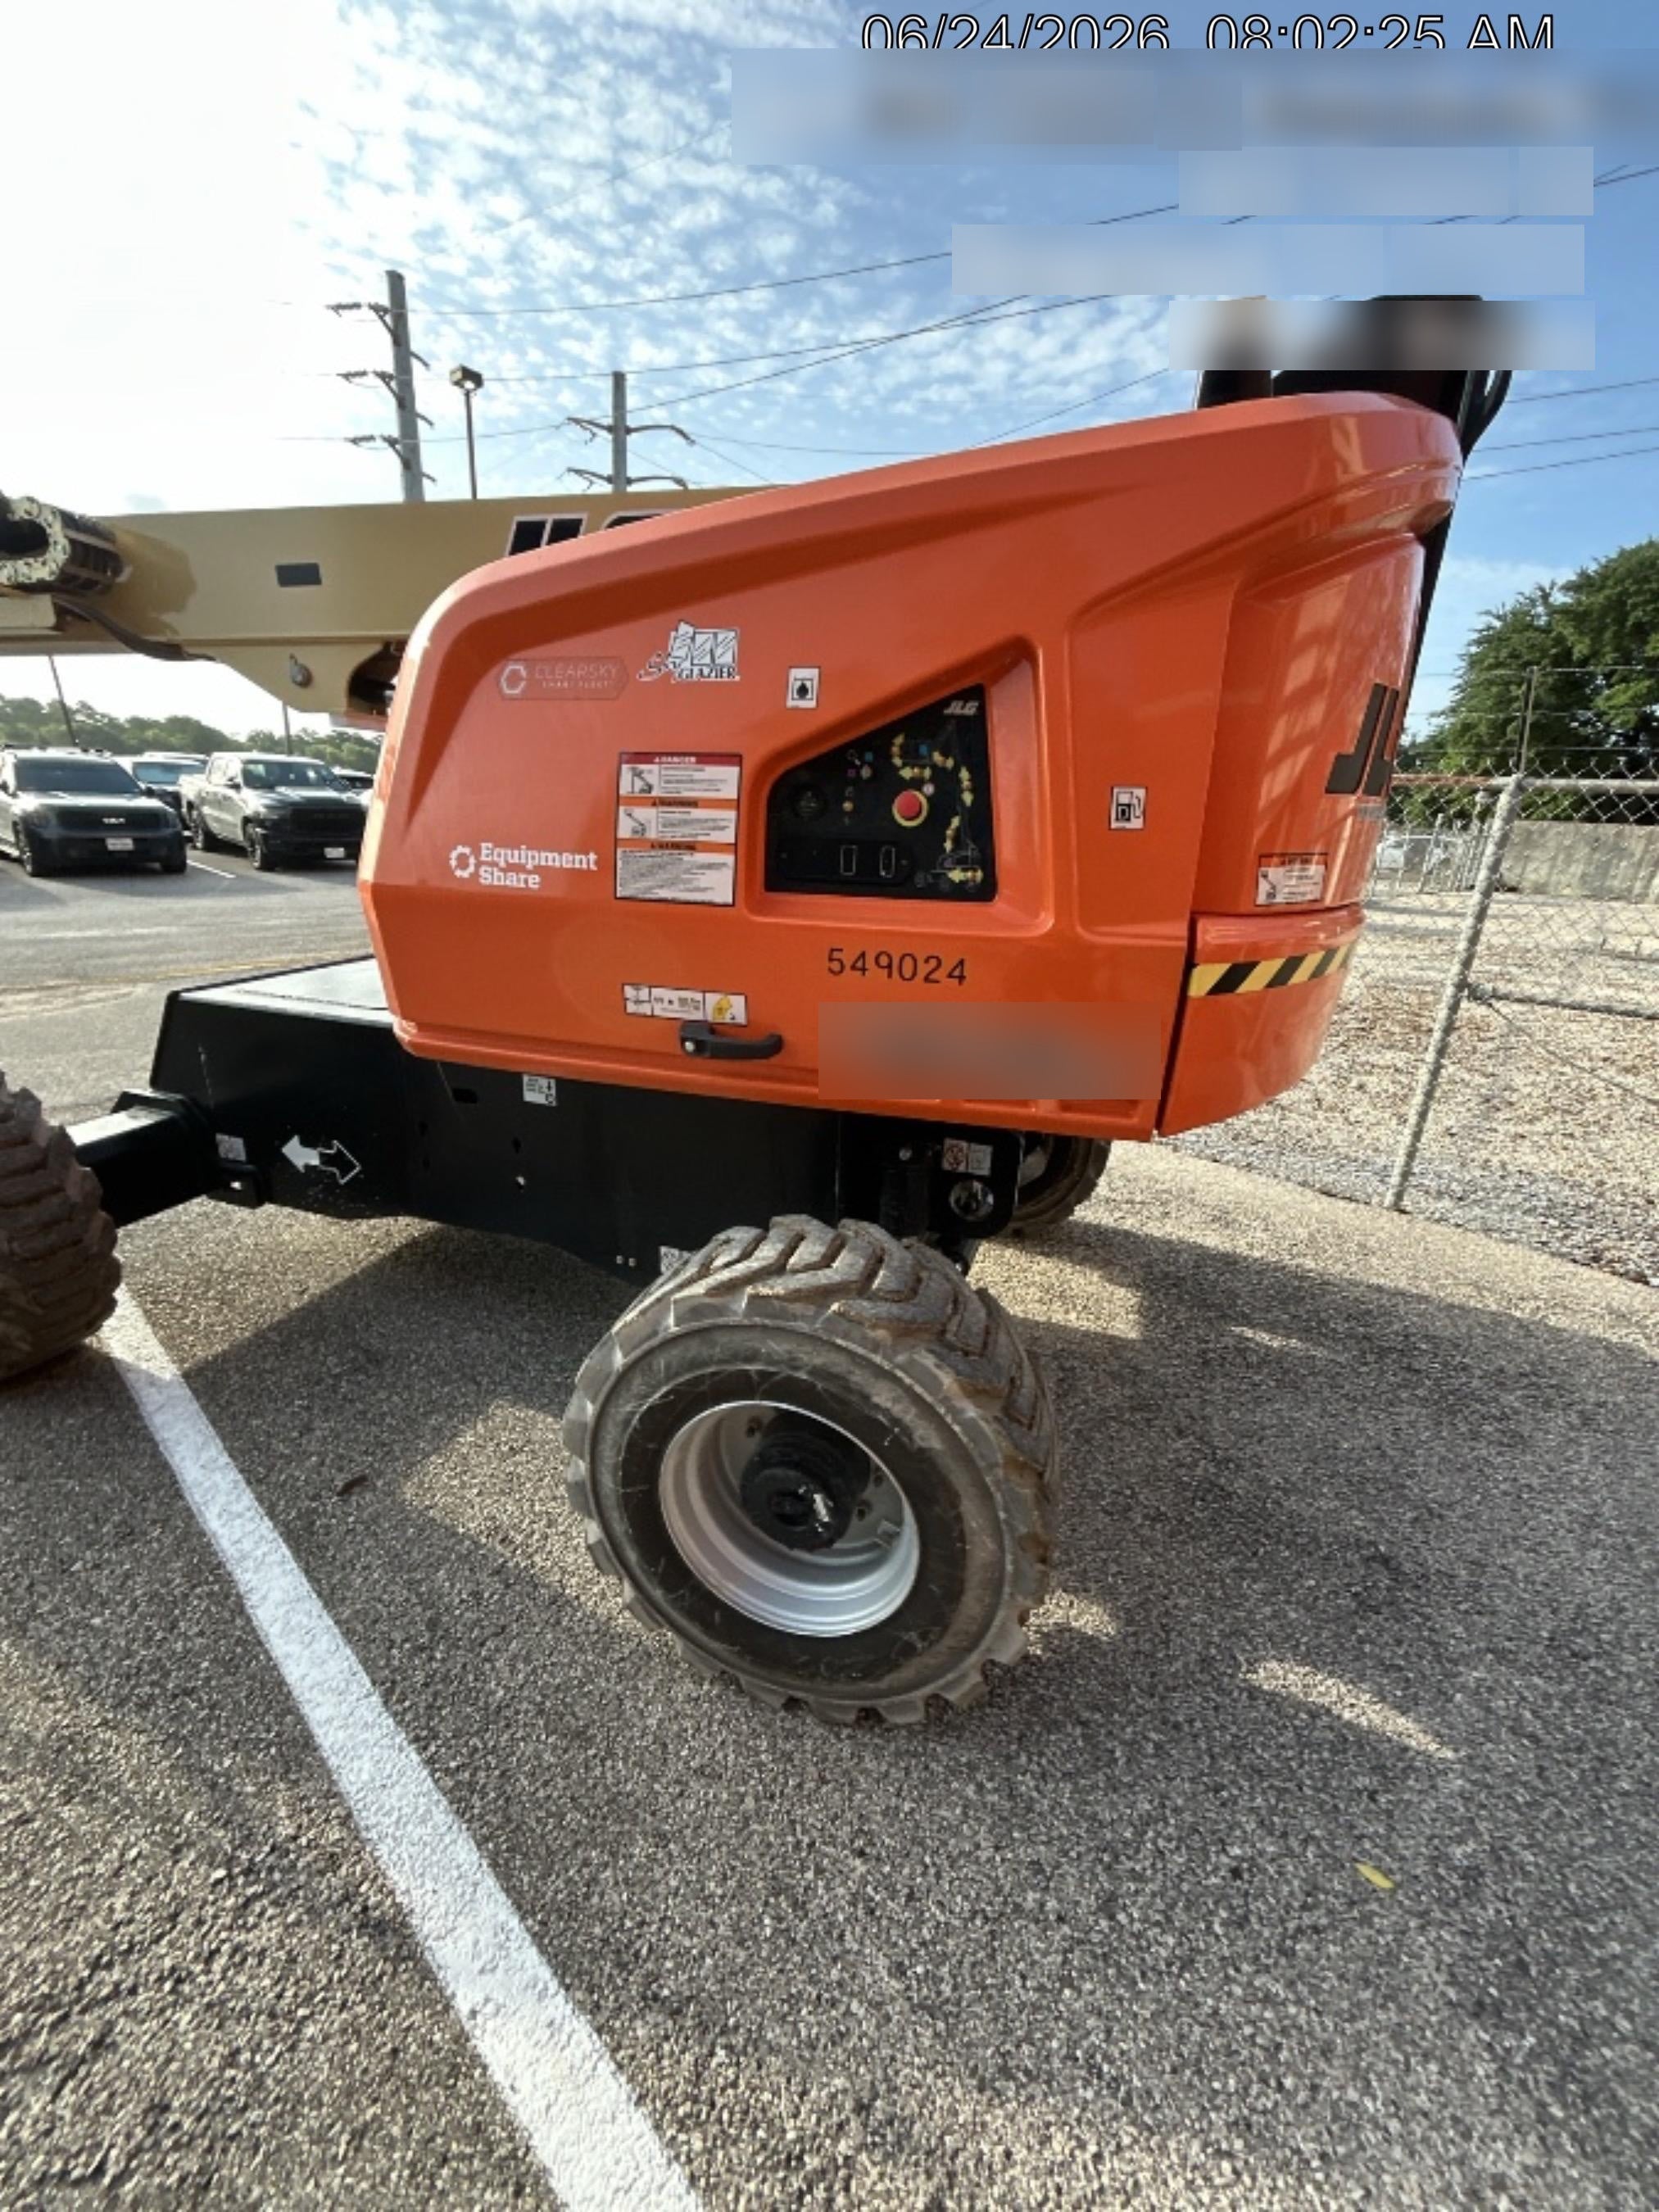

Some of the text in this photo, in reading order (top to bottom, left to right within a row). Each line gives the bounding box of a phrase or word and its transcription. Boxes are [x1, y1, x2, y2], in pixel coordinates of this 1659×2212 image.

[534, 661, 619, 679] CLEARSKY
[943, 700, 979, 715] JLG
[480, 843, 598, 870] Equipment
[479, 866, 541, 888] Share
[827, 947, 967, 986] 549024
